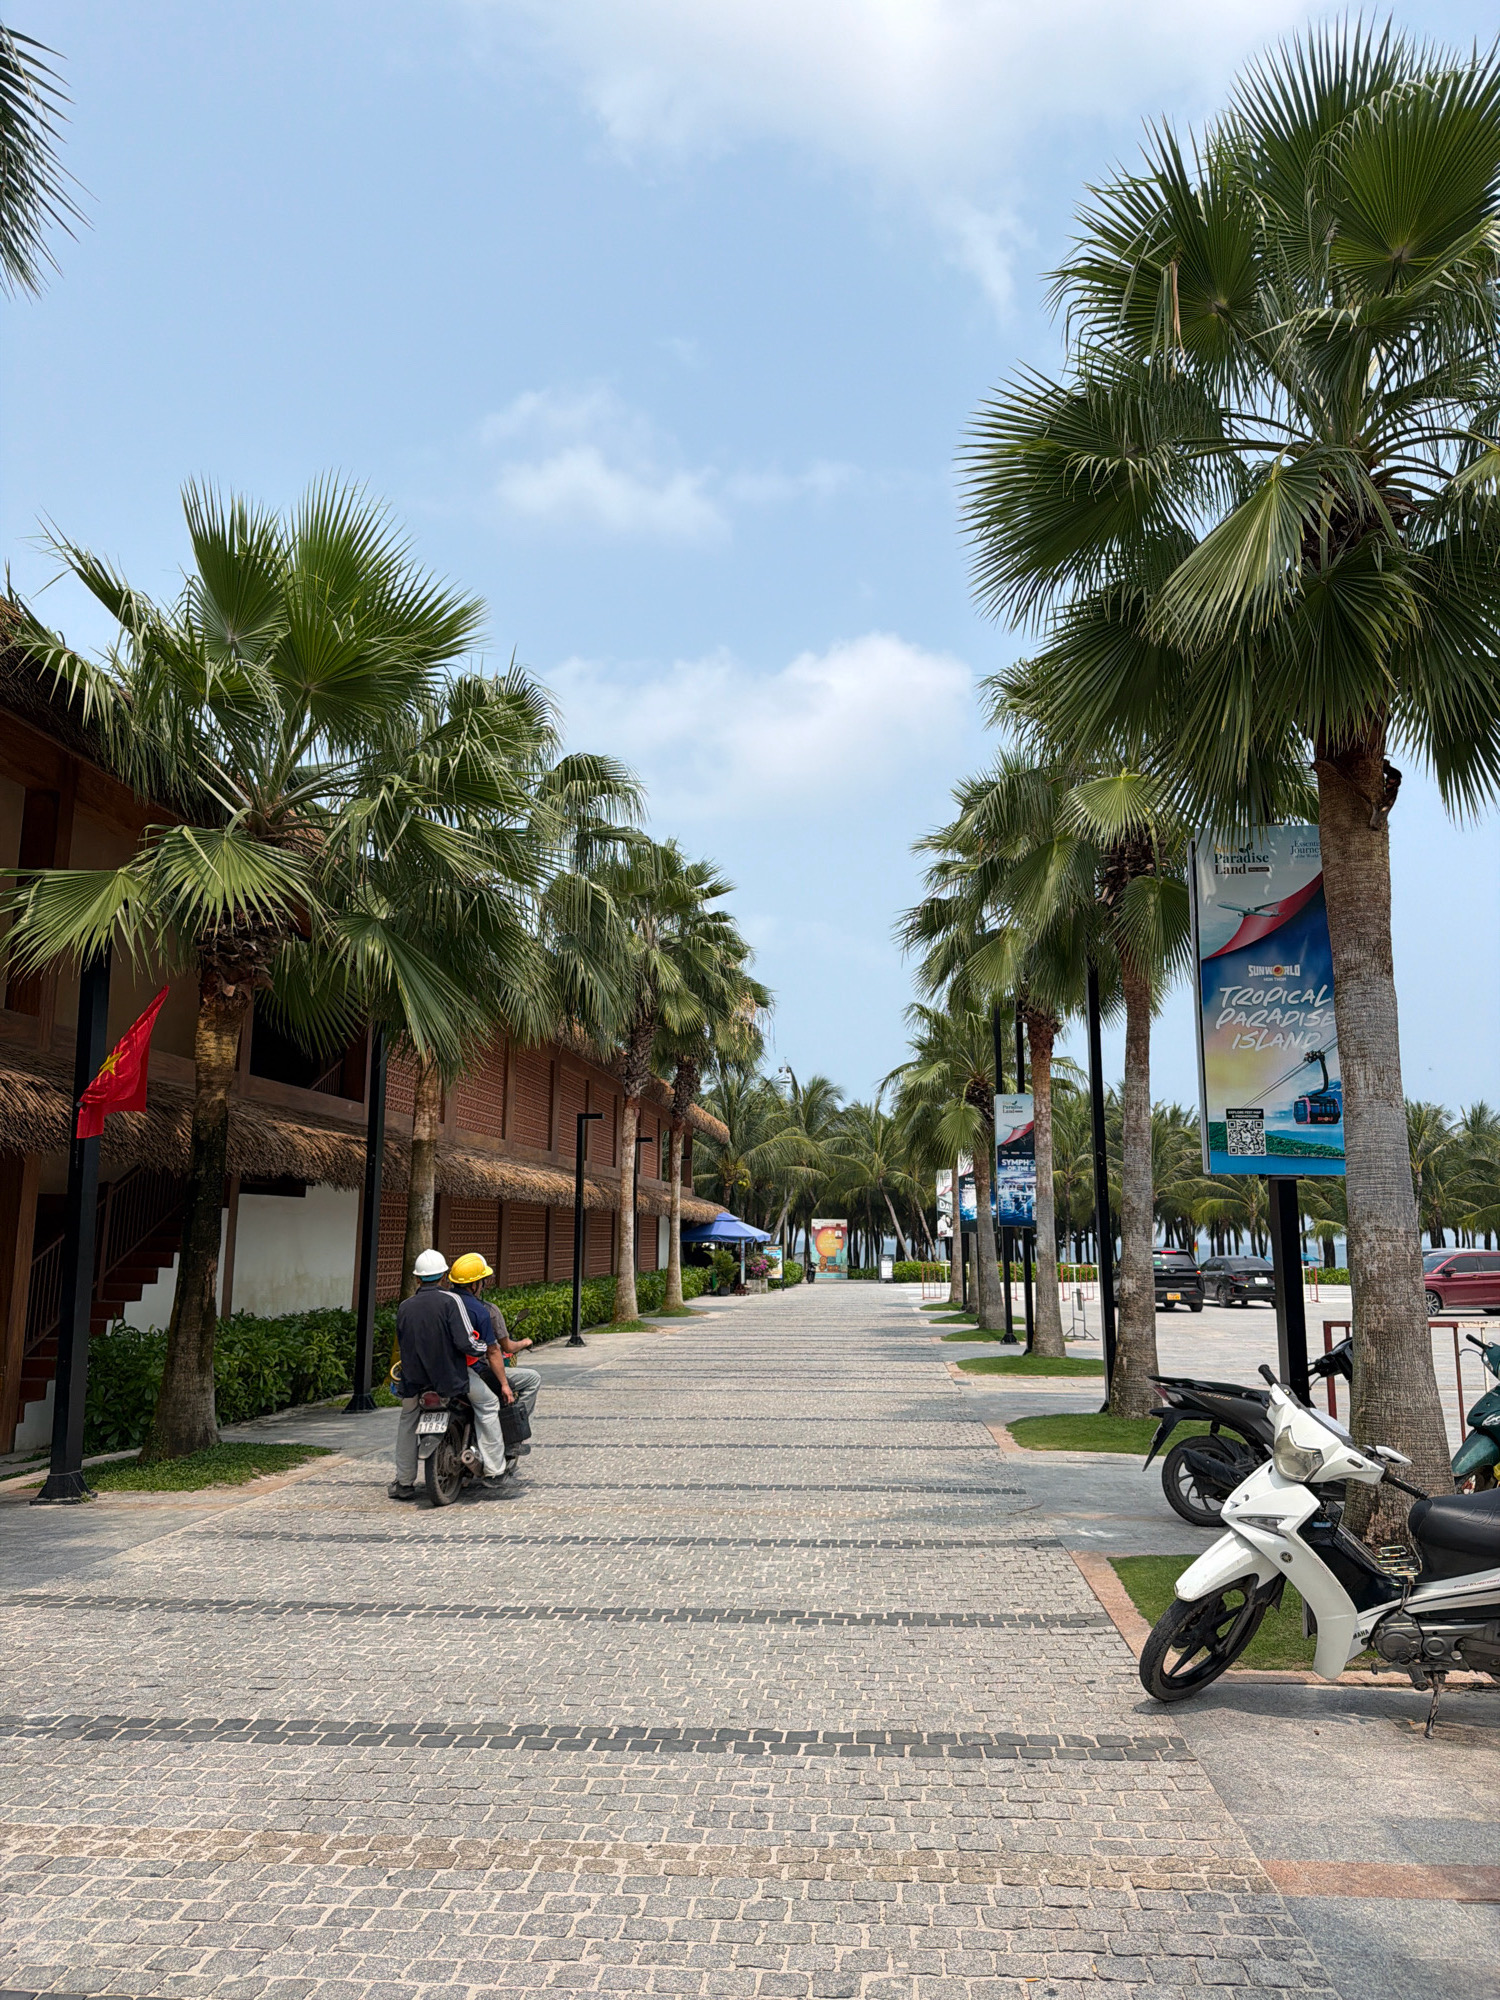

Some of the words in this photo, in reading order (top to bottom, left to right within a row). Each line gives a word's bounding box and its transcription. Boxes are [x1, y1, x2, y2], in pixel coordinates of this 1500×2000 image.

[1291, 846, 1320, 855] Journe
[1214, 853, 1269, 863] Paradise
[1215, 864, 1246, 875] Land
[1220, 985, 1332, 1008] TROPICAL
[1215, 1008, 1336, 1029] PARADISE
[1232, 1029, 1321, 1051] ISLAND
[1353, 1629, 1369, 1639] MAHA
